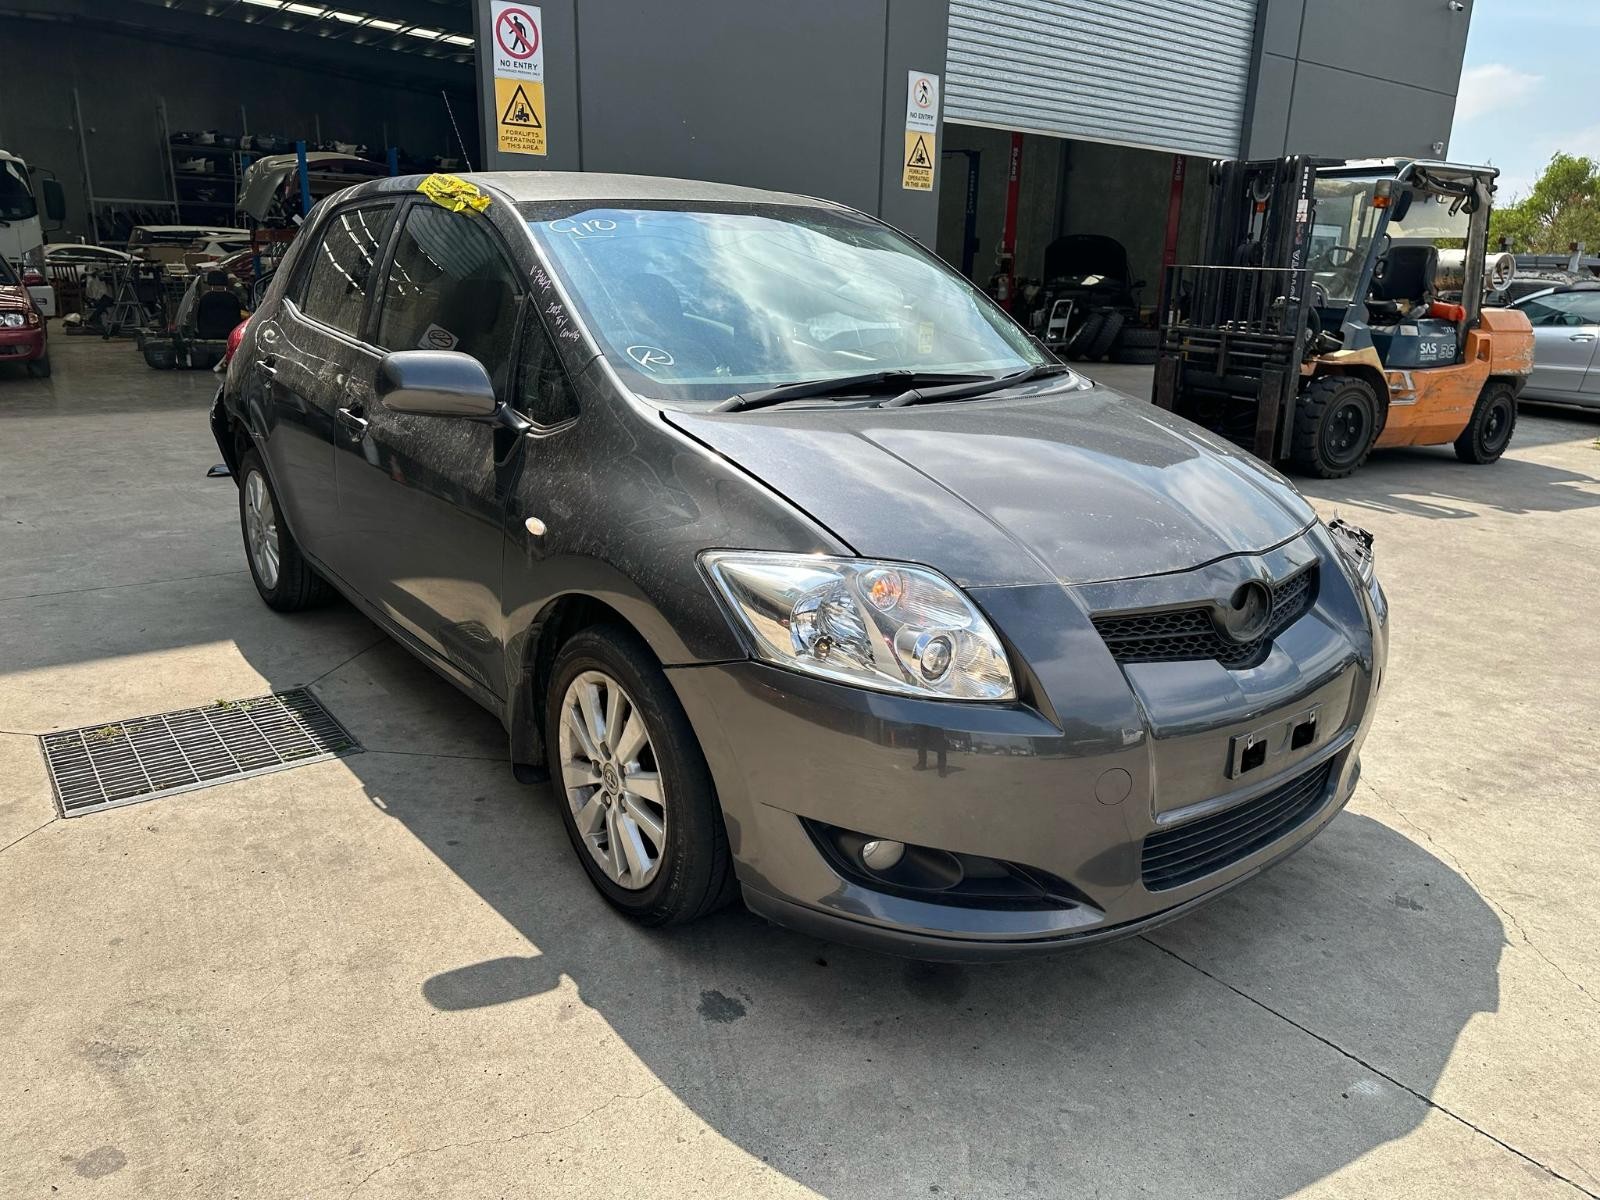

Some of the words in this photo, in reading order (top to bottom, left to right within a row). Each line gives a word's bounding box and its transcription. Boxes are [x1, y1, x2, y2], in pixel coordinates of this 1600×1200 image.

[513, 61, 538, 70] ENTRY
[505, 130, 539, 138] FORKLIFTS
[501, 135, 536, 144] OPERATING
[1419, 342, 1437, 354] SAS
